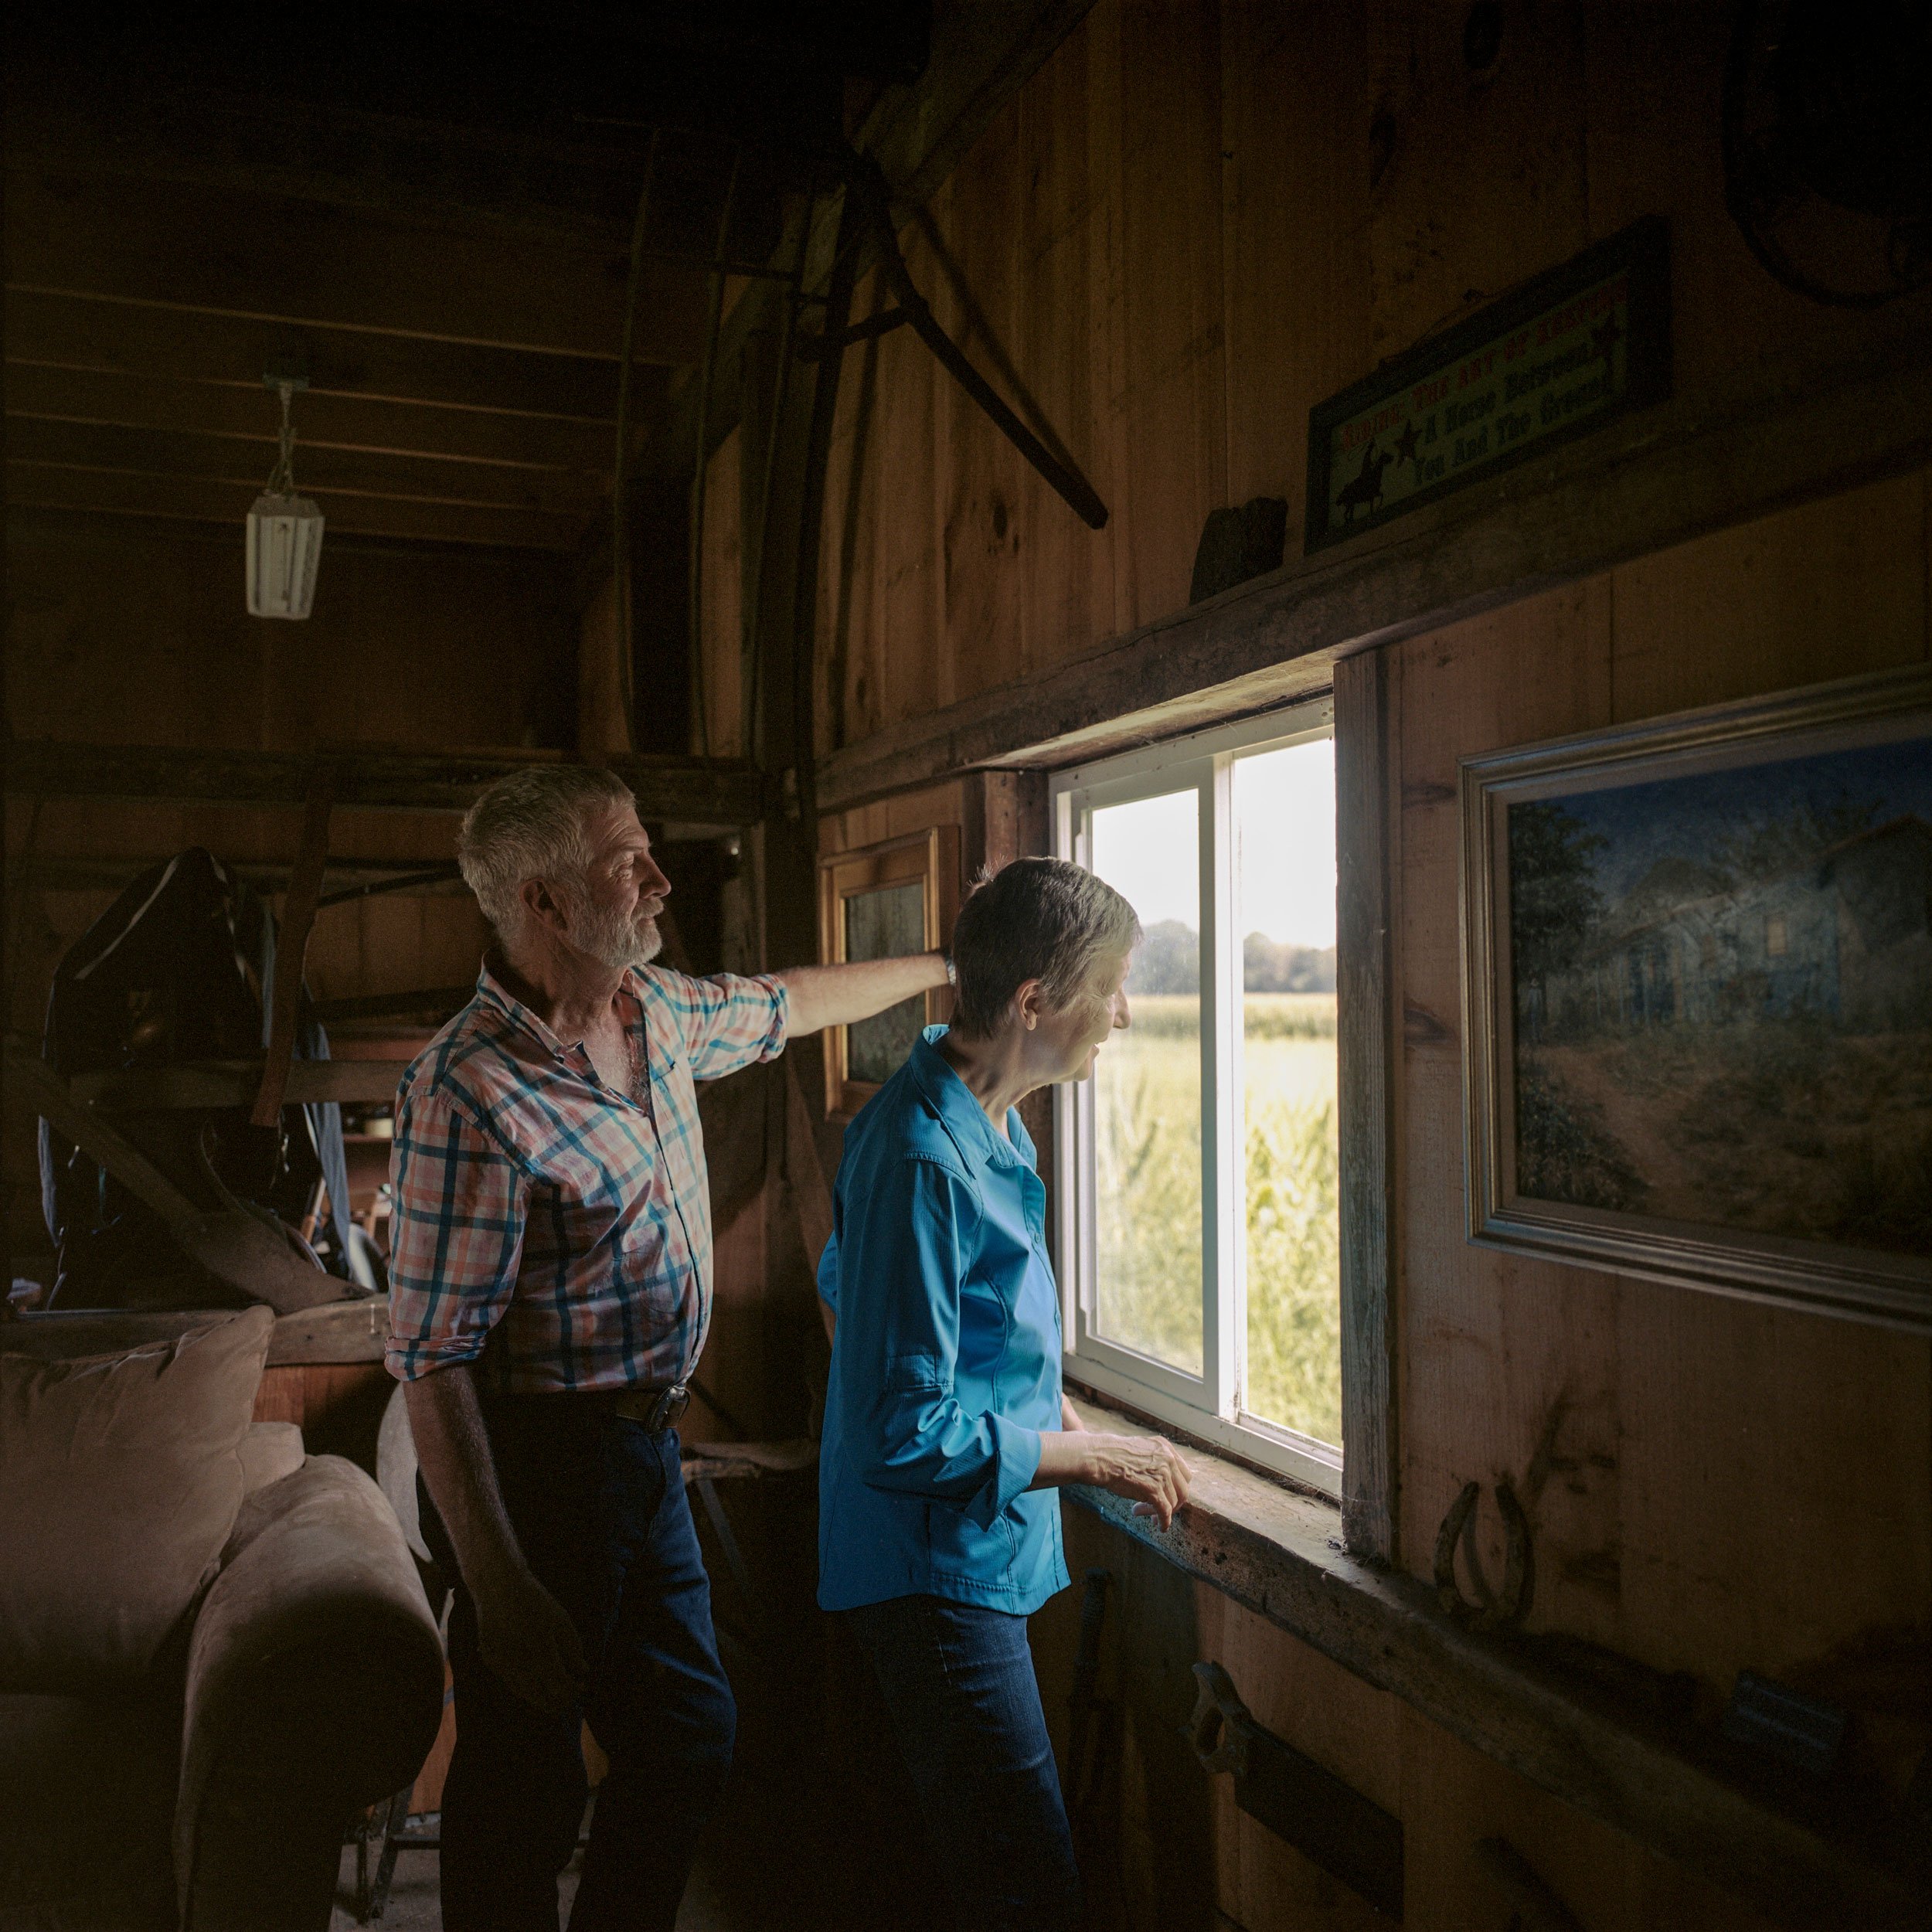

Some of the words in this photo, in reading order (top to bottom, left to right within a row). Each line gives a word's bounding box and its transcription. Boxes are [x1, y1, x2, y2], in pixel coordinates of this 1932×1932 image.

[1412, 376, 1449, 411] THE
[1458, 349, 1495, 389] ART
[1504, 330, 1530, 363] OF
[1444, 391, 1496, 434] Horse
[1504, 342, 1589, 403] Between
[1413, 454, 1444, 485] You
[1451, 425, 1488, 467] And
[1496, 411, 1531, 446] The
